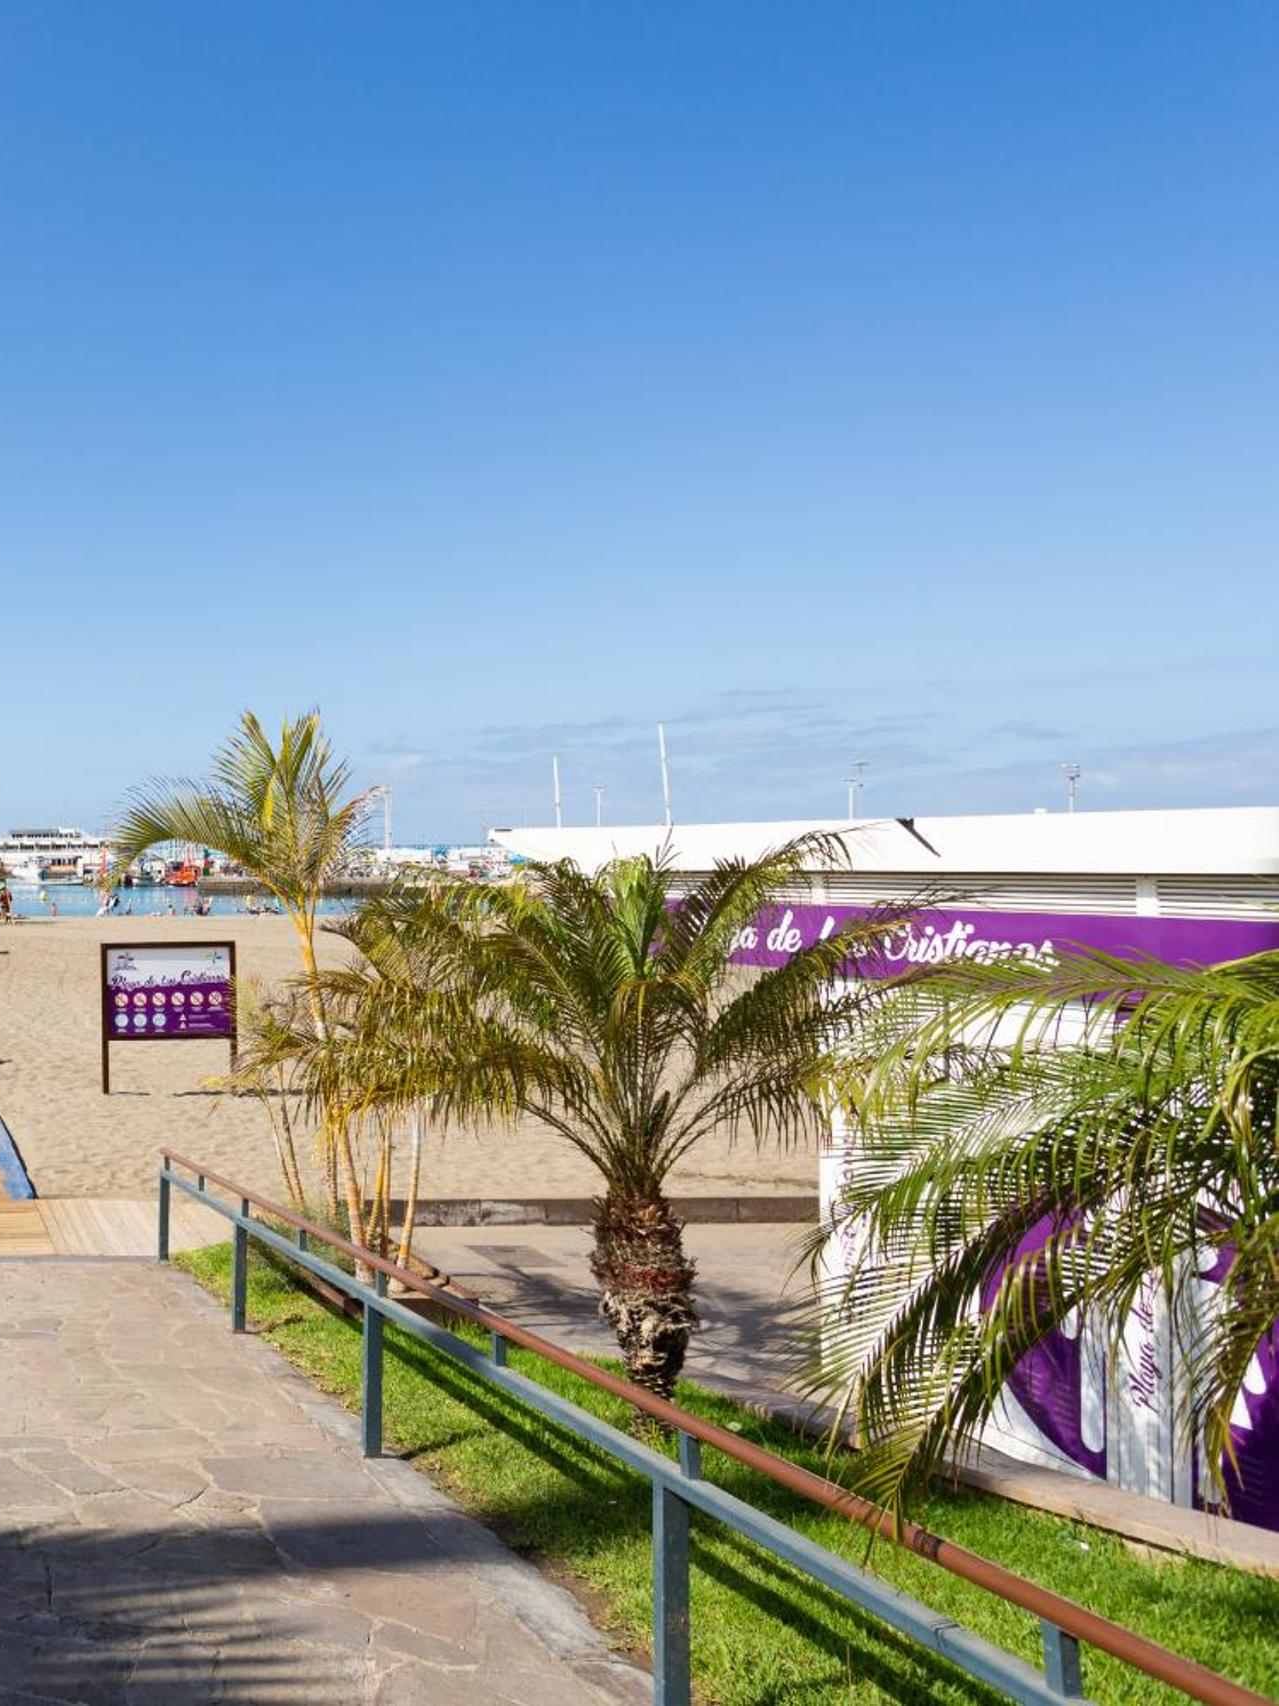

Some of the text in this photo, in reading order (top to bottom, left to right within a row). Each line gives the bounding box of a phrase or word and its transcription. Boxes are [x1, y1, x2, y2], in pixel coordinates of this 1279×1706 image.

[766, 909, 803, 953] de
[1128, 1301, 1156, 1334] de
[1127, 1343, 1163, 1415] Playa
